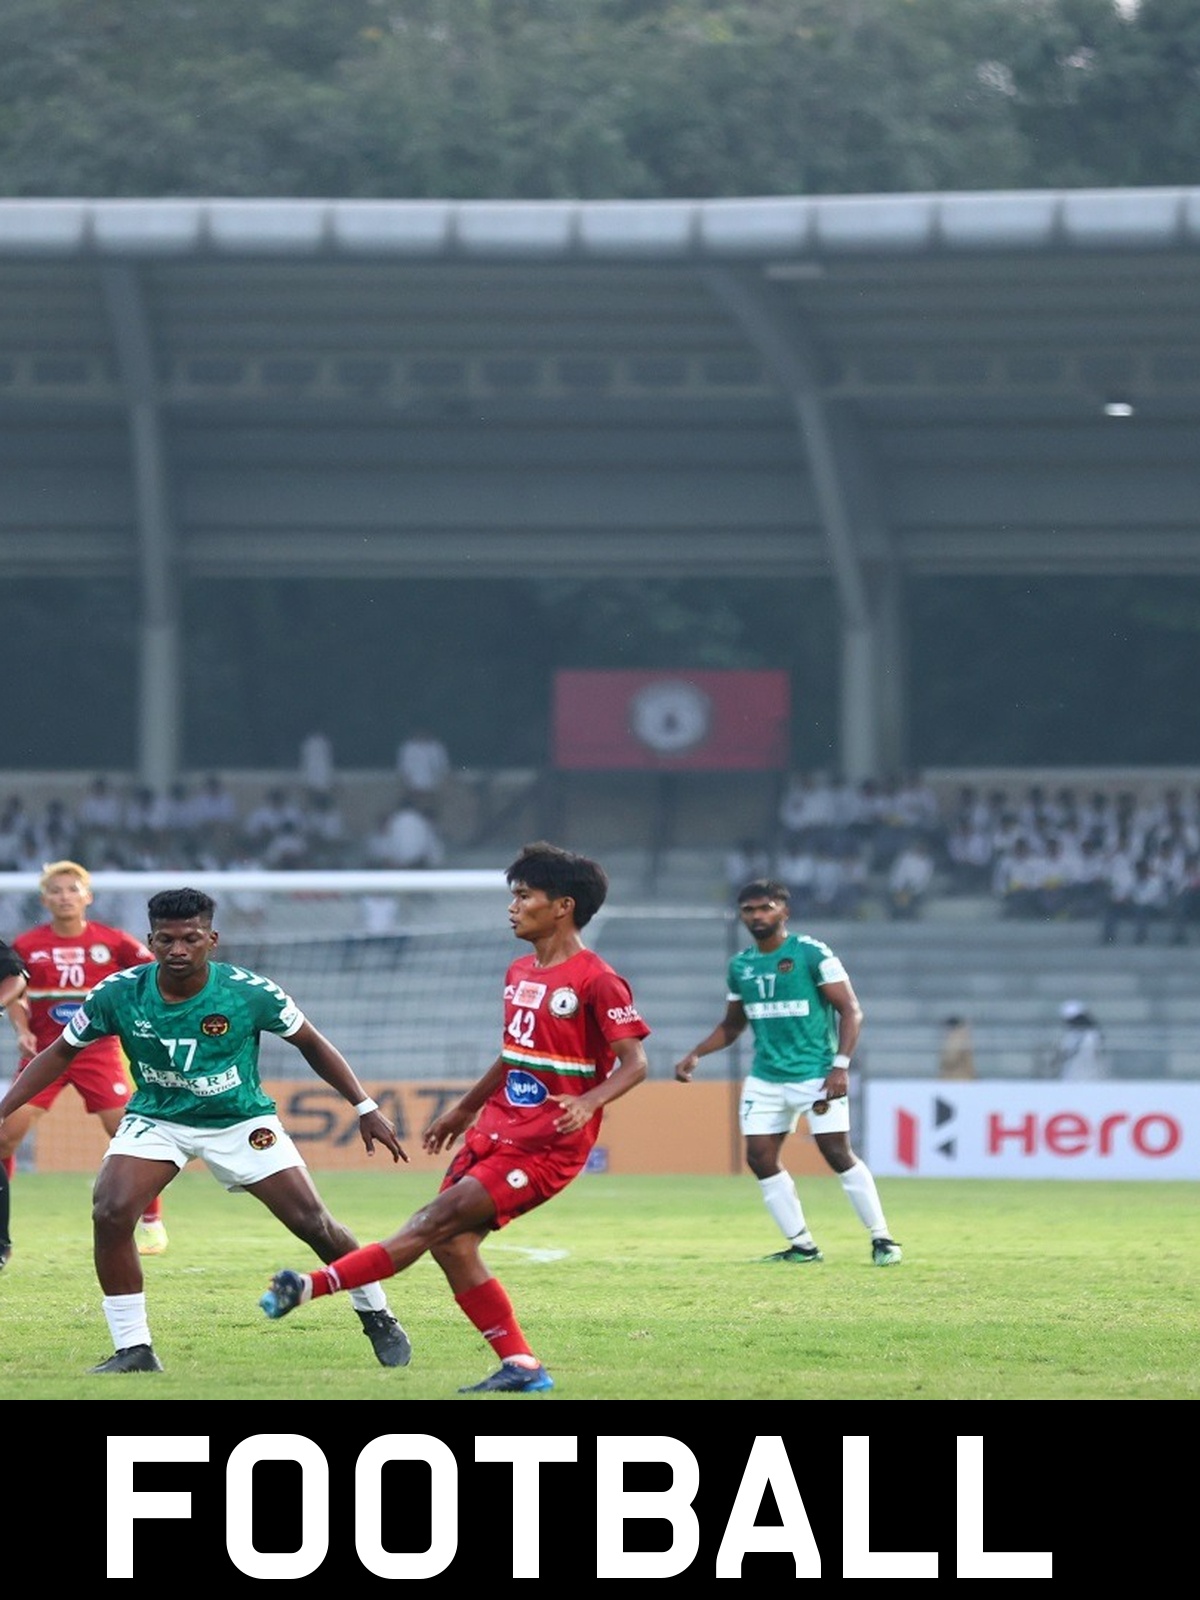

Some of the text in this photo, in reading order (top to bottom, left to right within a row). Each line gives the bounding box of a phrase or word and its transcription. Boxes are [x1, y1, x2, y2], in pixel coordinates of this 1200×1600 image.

[56, 964, 85, 988] 70
[754, 973, 776, 999] 17
[508, 1009, 535, 1048] 42
[160, 1038, 197, 1072] 77
[123, 1116, 156, 1138] 77
[987, 1112, 1182, 1158] Hero
